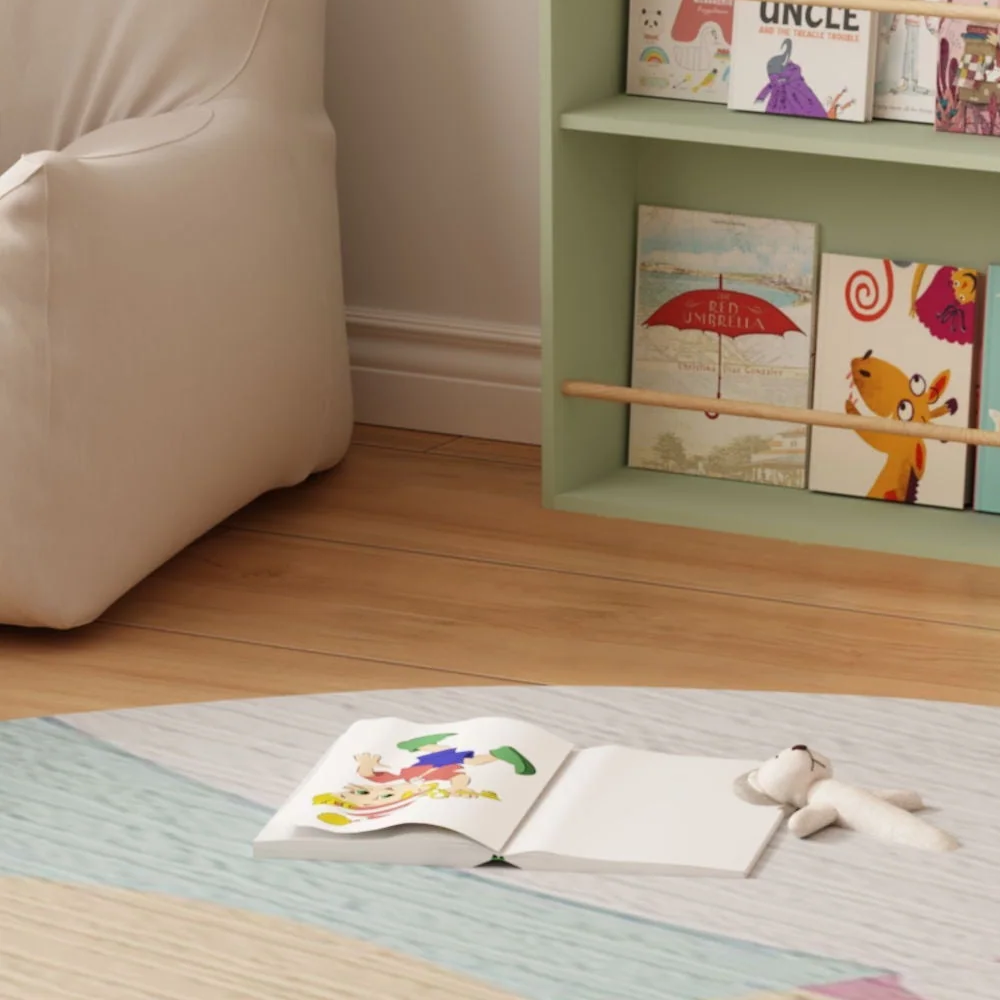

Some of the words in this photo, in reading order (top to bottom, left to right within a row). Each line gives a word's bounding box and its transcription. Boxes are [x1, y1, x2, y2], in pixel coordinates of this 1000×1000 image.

[759, 0, 860, 32] UNCLE
[708, 300, 739, 314] RED
[683, 311, 766, 331] UMBRELLA
